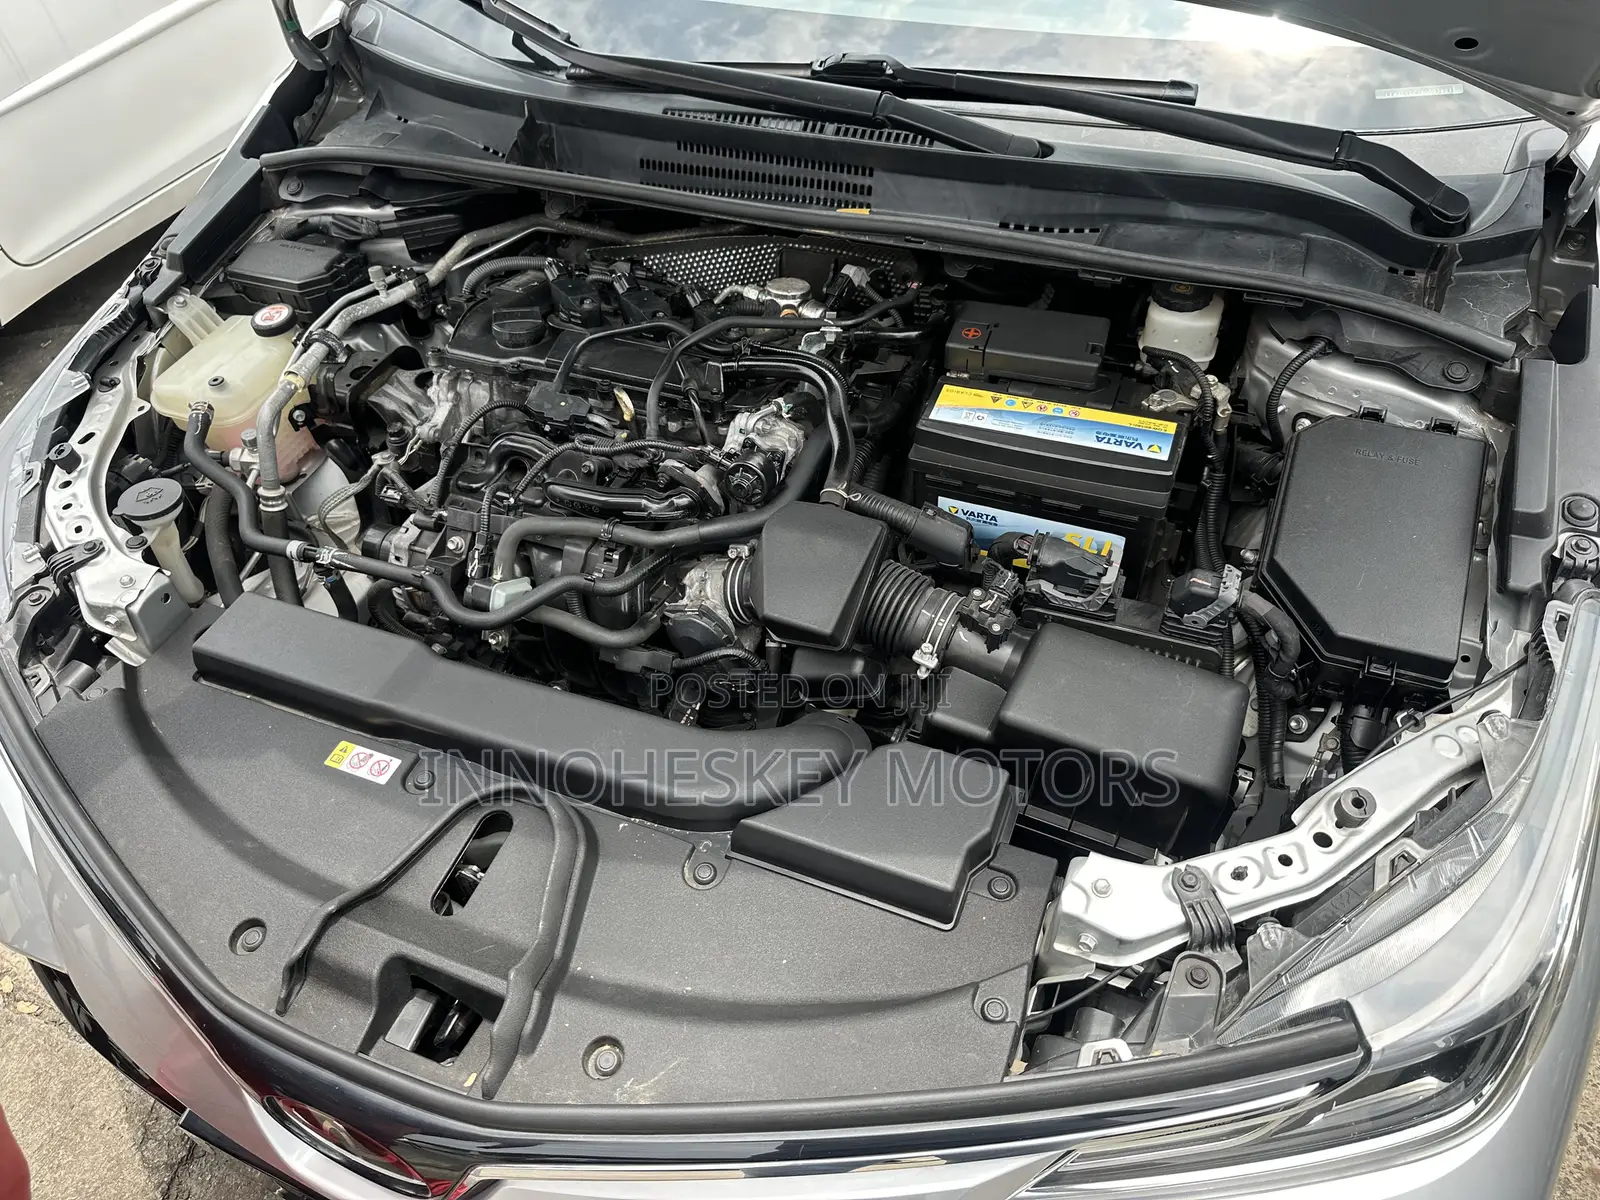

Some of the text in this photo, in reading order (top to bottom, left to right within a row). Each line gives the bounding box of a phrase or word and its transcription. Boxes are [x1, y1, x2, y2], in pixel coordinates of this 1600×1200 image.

[1095, 434, 1144, 451] VARTA
[1355, 448, 1421, 467] RELAY & FUSE
[961, 508, 998, 523] VARTA
